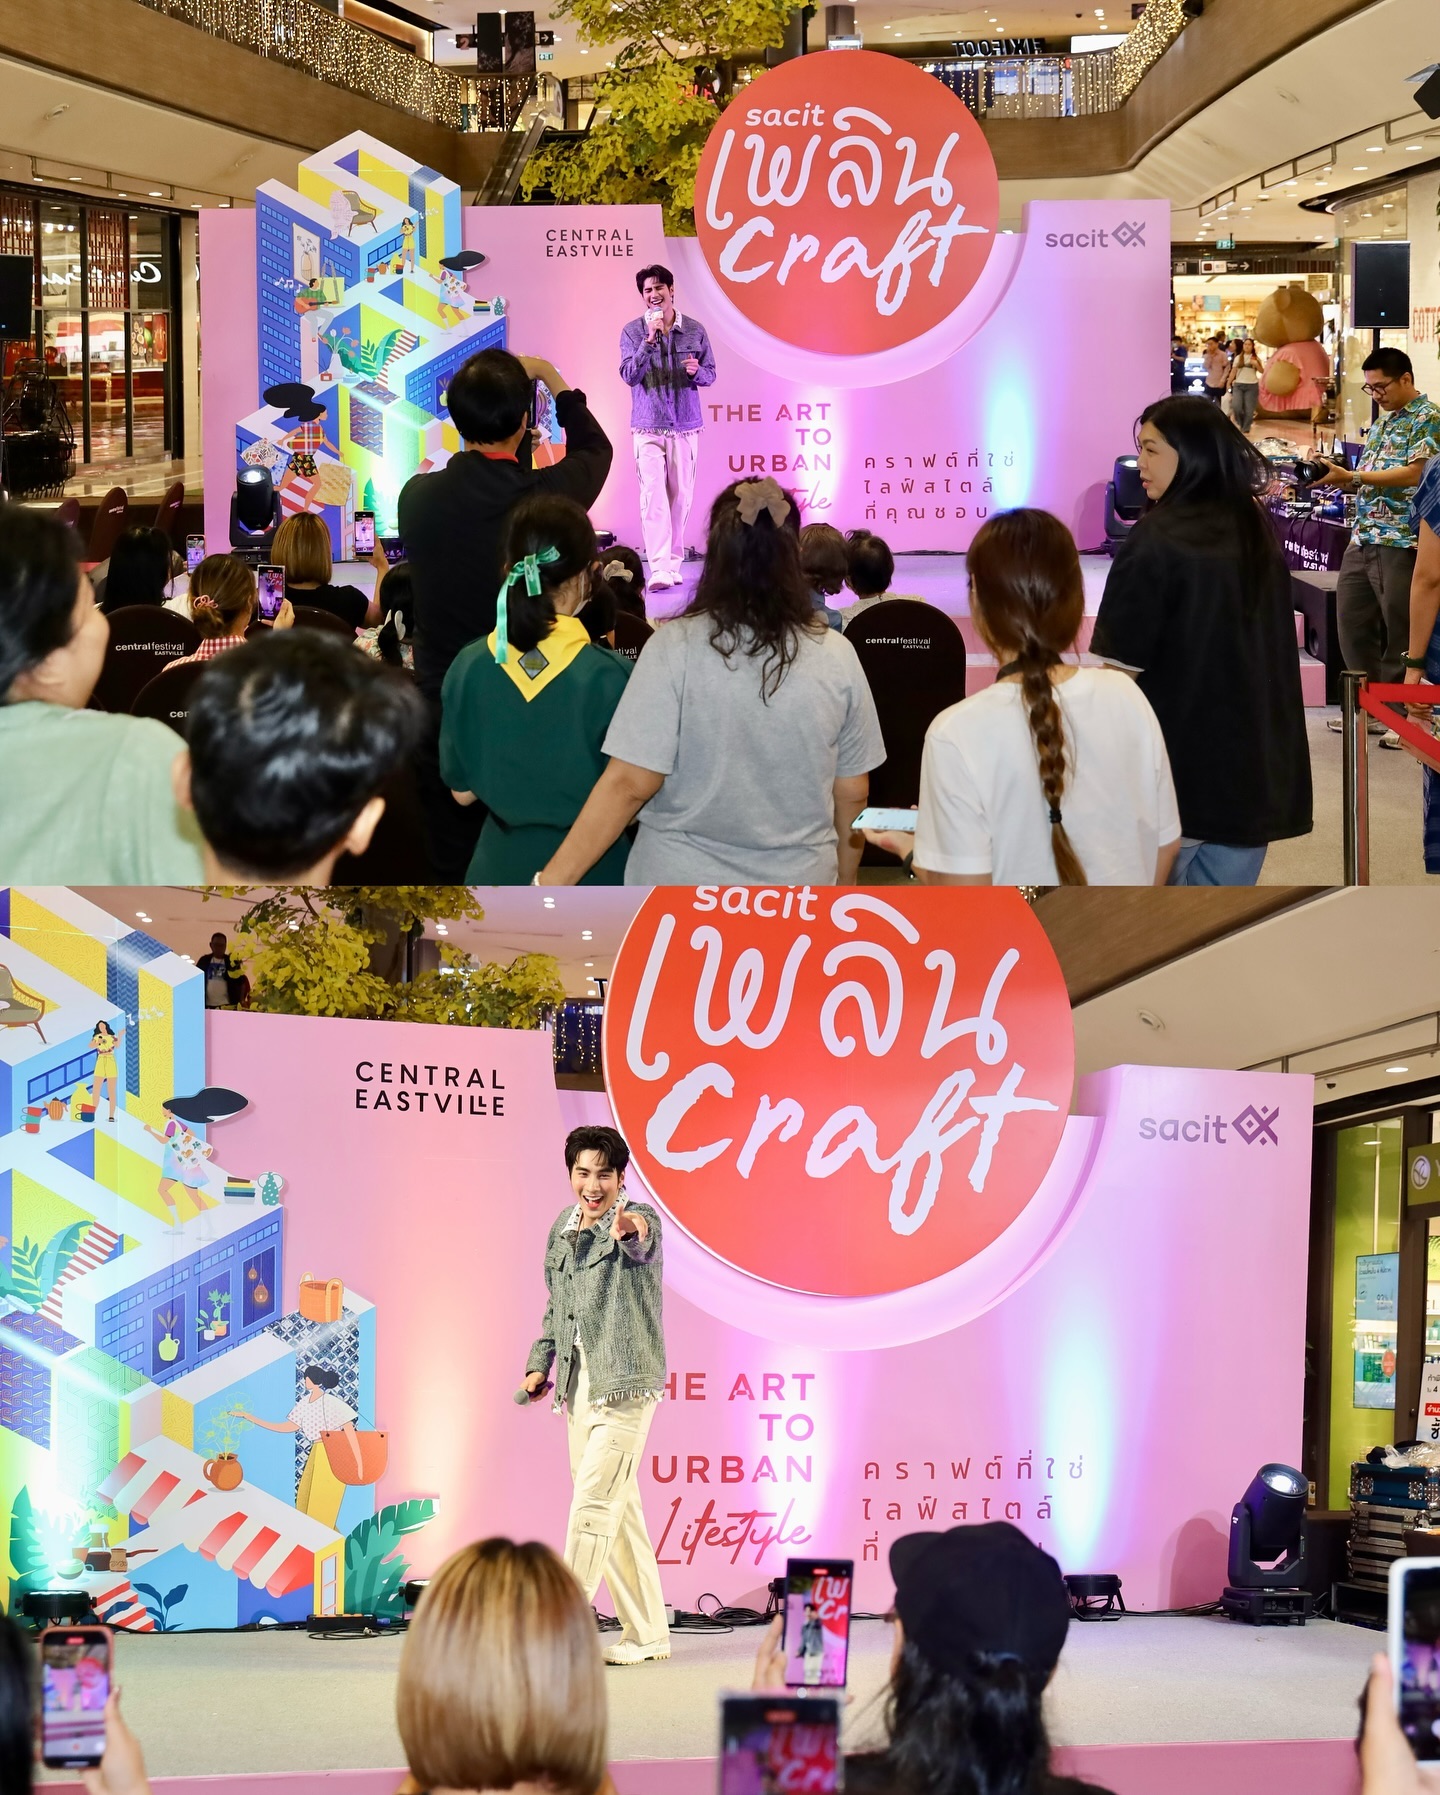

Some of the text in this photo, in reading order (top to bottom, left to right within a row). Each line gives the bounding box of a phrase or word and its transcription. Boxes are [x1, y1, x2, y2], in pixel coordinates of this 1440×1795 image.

[745, 102, 825, 127] sacit
[706, 106, 960, 230] เพลิน
[546, 229, 634, 241] CENTRAL
[1045, 229, 1109, 248] sacit
[546, 244, 634, 257] EASTVILLE
[708, 403, 831, 422] THE ART
[795, 428, 832, 445] TO
[728, 454, 831, 472] URBAN
[692, 886, 818, 921] sacit
[626, 893, 1020, 1081] เพลิน
[355, 1061, 505, 1090] CENTRAL
[355, 1088, 505, 1117] EASTVILLE
[1138, 1114, 1228, 1144] sacit
[665, 1372, 815, 1400] HE ART
[759, 1413, 814, 1441] TO
[652, 1455, 812, 1484] URBAN
